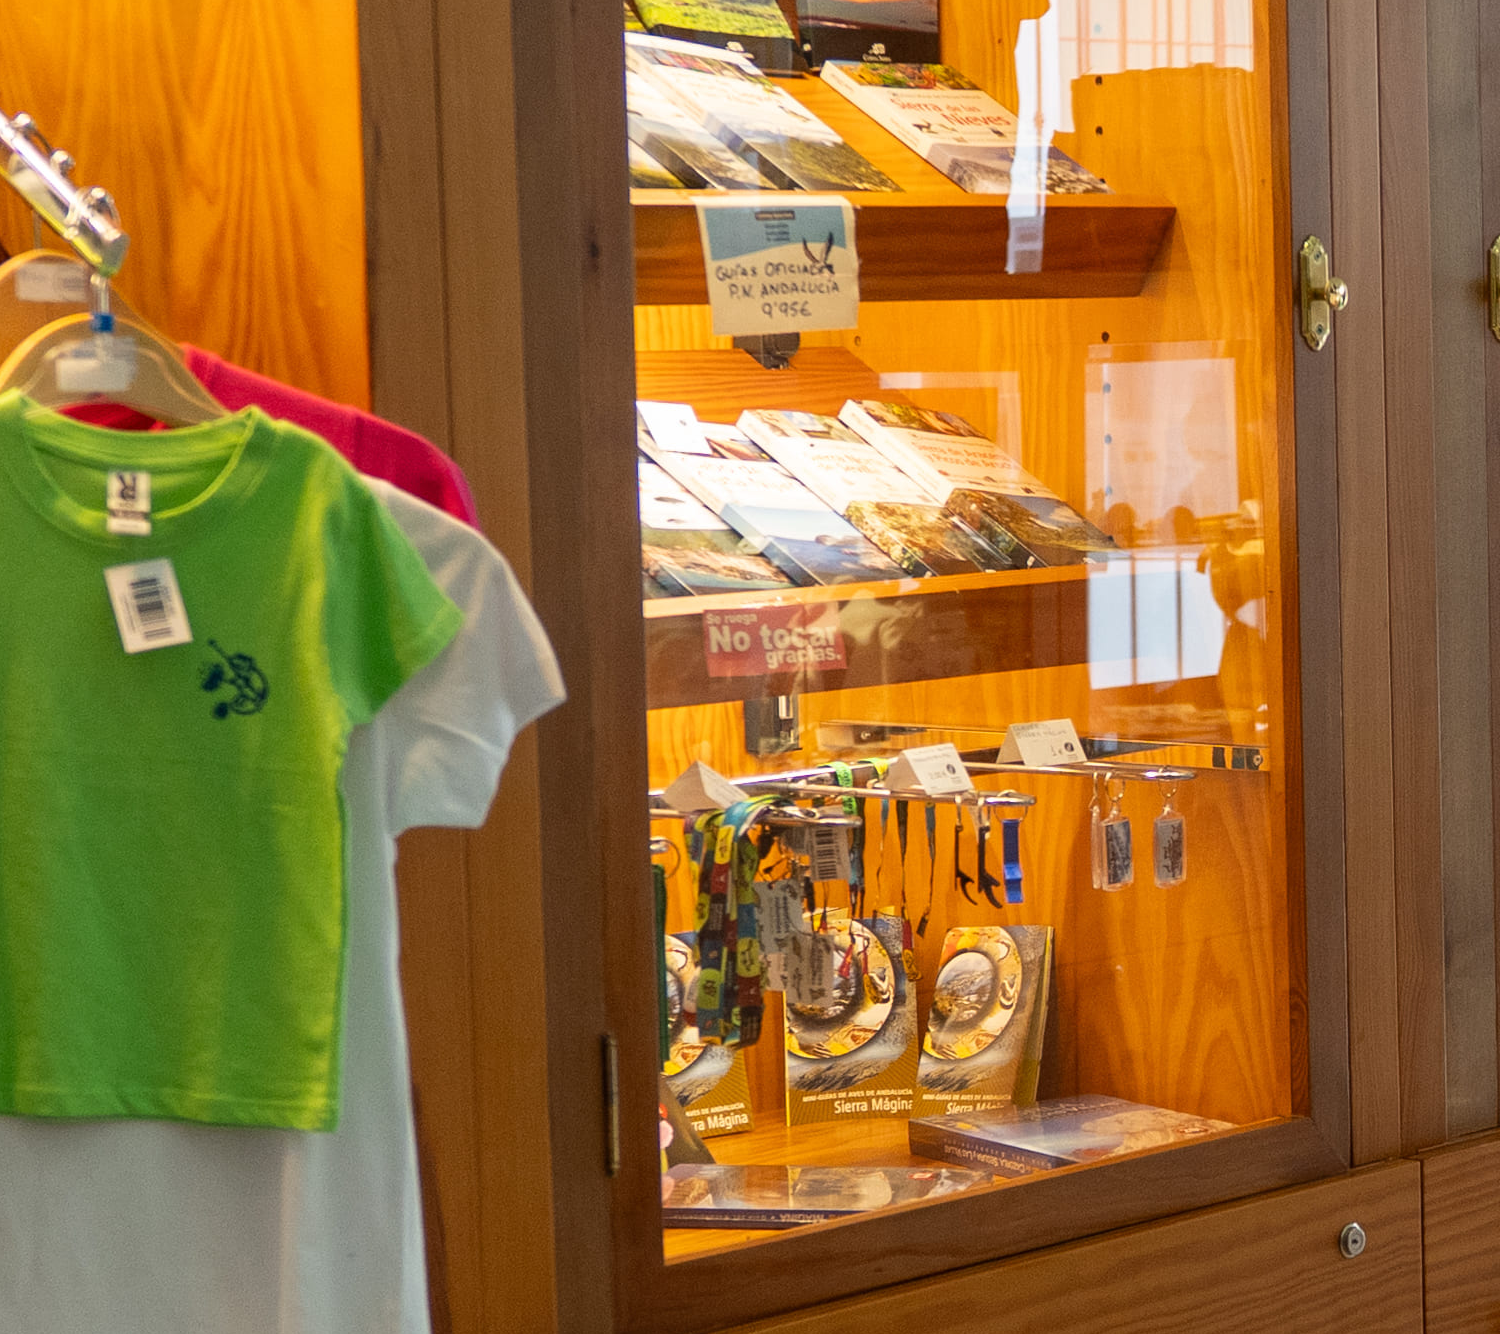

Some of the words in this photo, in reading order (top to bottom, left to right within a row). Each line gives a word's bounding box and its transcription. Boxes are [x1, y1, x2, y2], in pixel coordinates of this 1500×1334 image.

[890, 98, 943, 112] Sierra
[940, 112, 1011, 126] Nieves
[706, 613, 722, 624] Se
[708, 625, 751, 653] No
[759, 623, 837, 651] tocar
[765, 645, 842, 670] gracias.
[834, 1099, 868, 1114] Sierra
[945, 1101, 974, 1115] Sierra
[707, 1112, 749, 1130] Mágina
